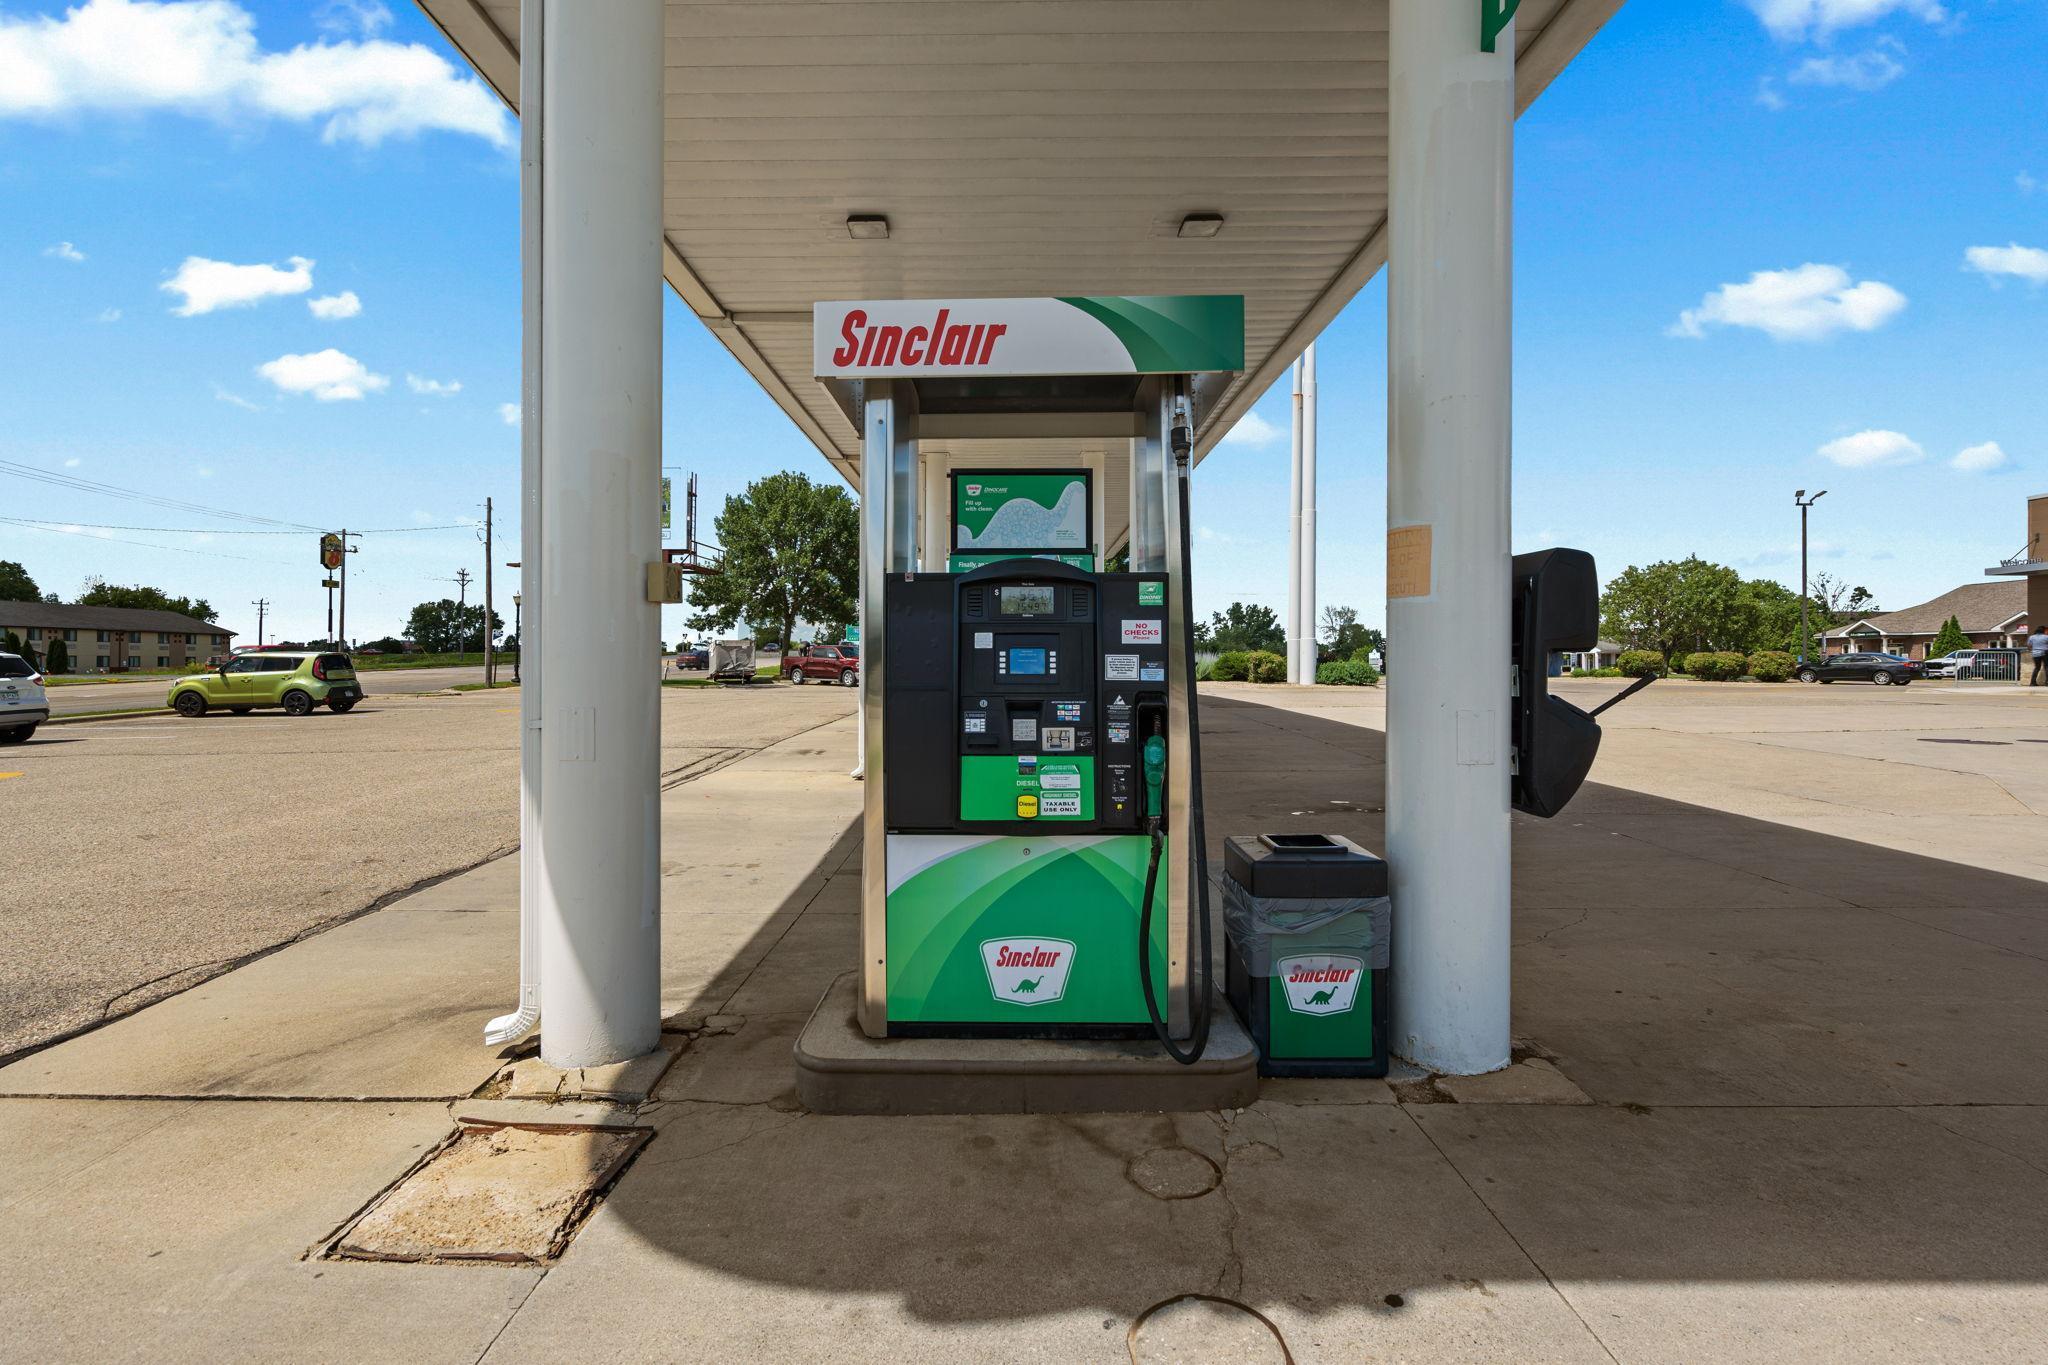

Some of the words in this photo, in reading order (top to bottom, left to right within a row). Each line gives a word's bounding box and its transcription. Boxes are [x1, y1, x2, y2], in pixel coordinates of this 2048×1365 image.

[832, 308, 1007, 367] Sinclair
[2000, 558, 2043, 567] Welcome
[996, 945, 1061, 967] Sinclair
[1289, 964, 1354, 982] Sinclair
